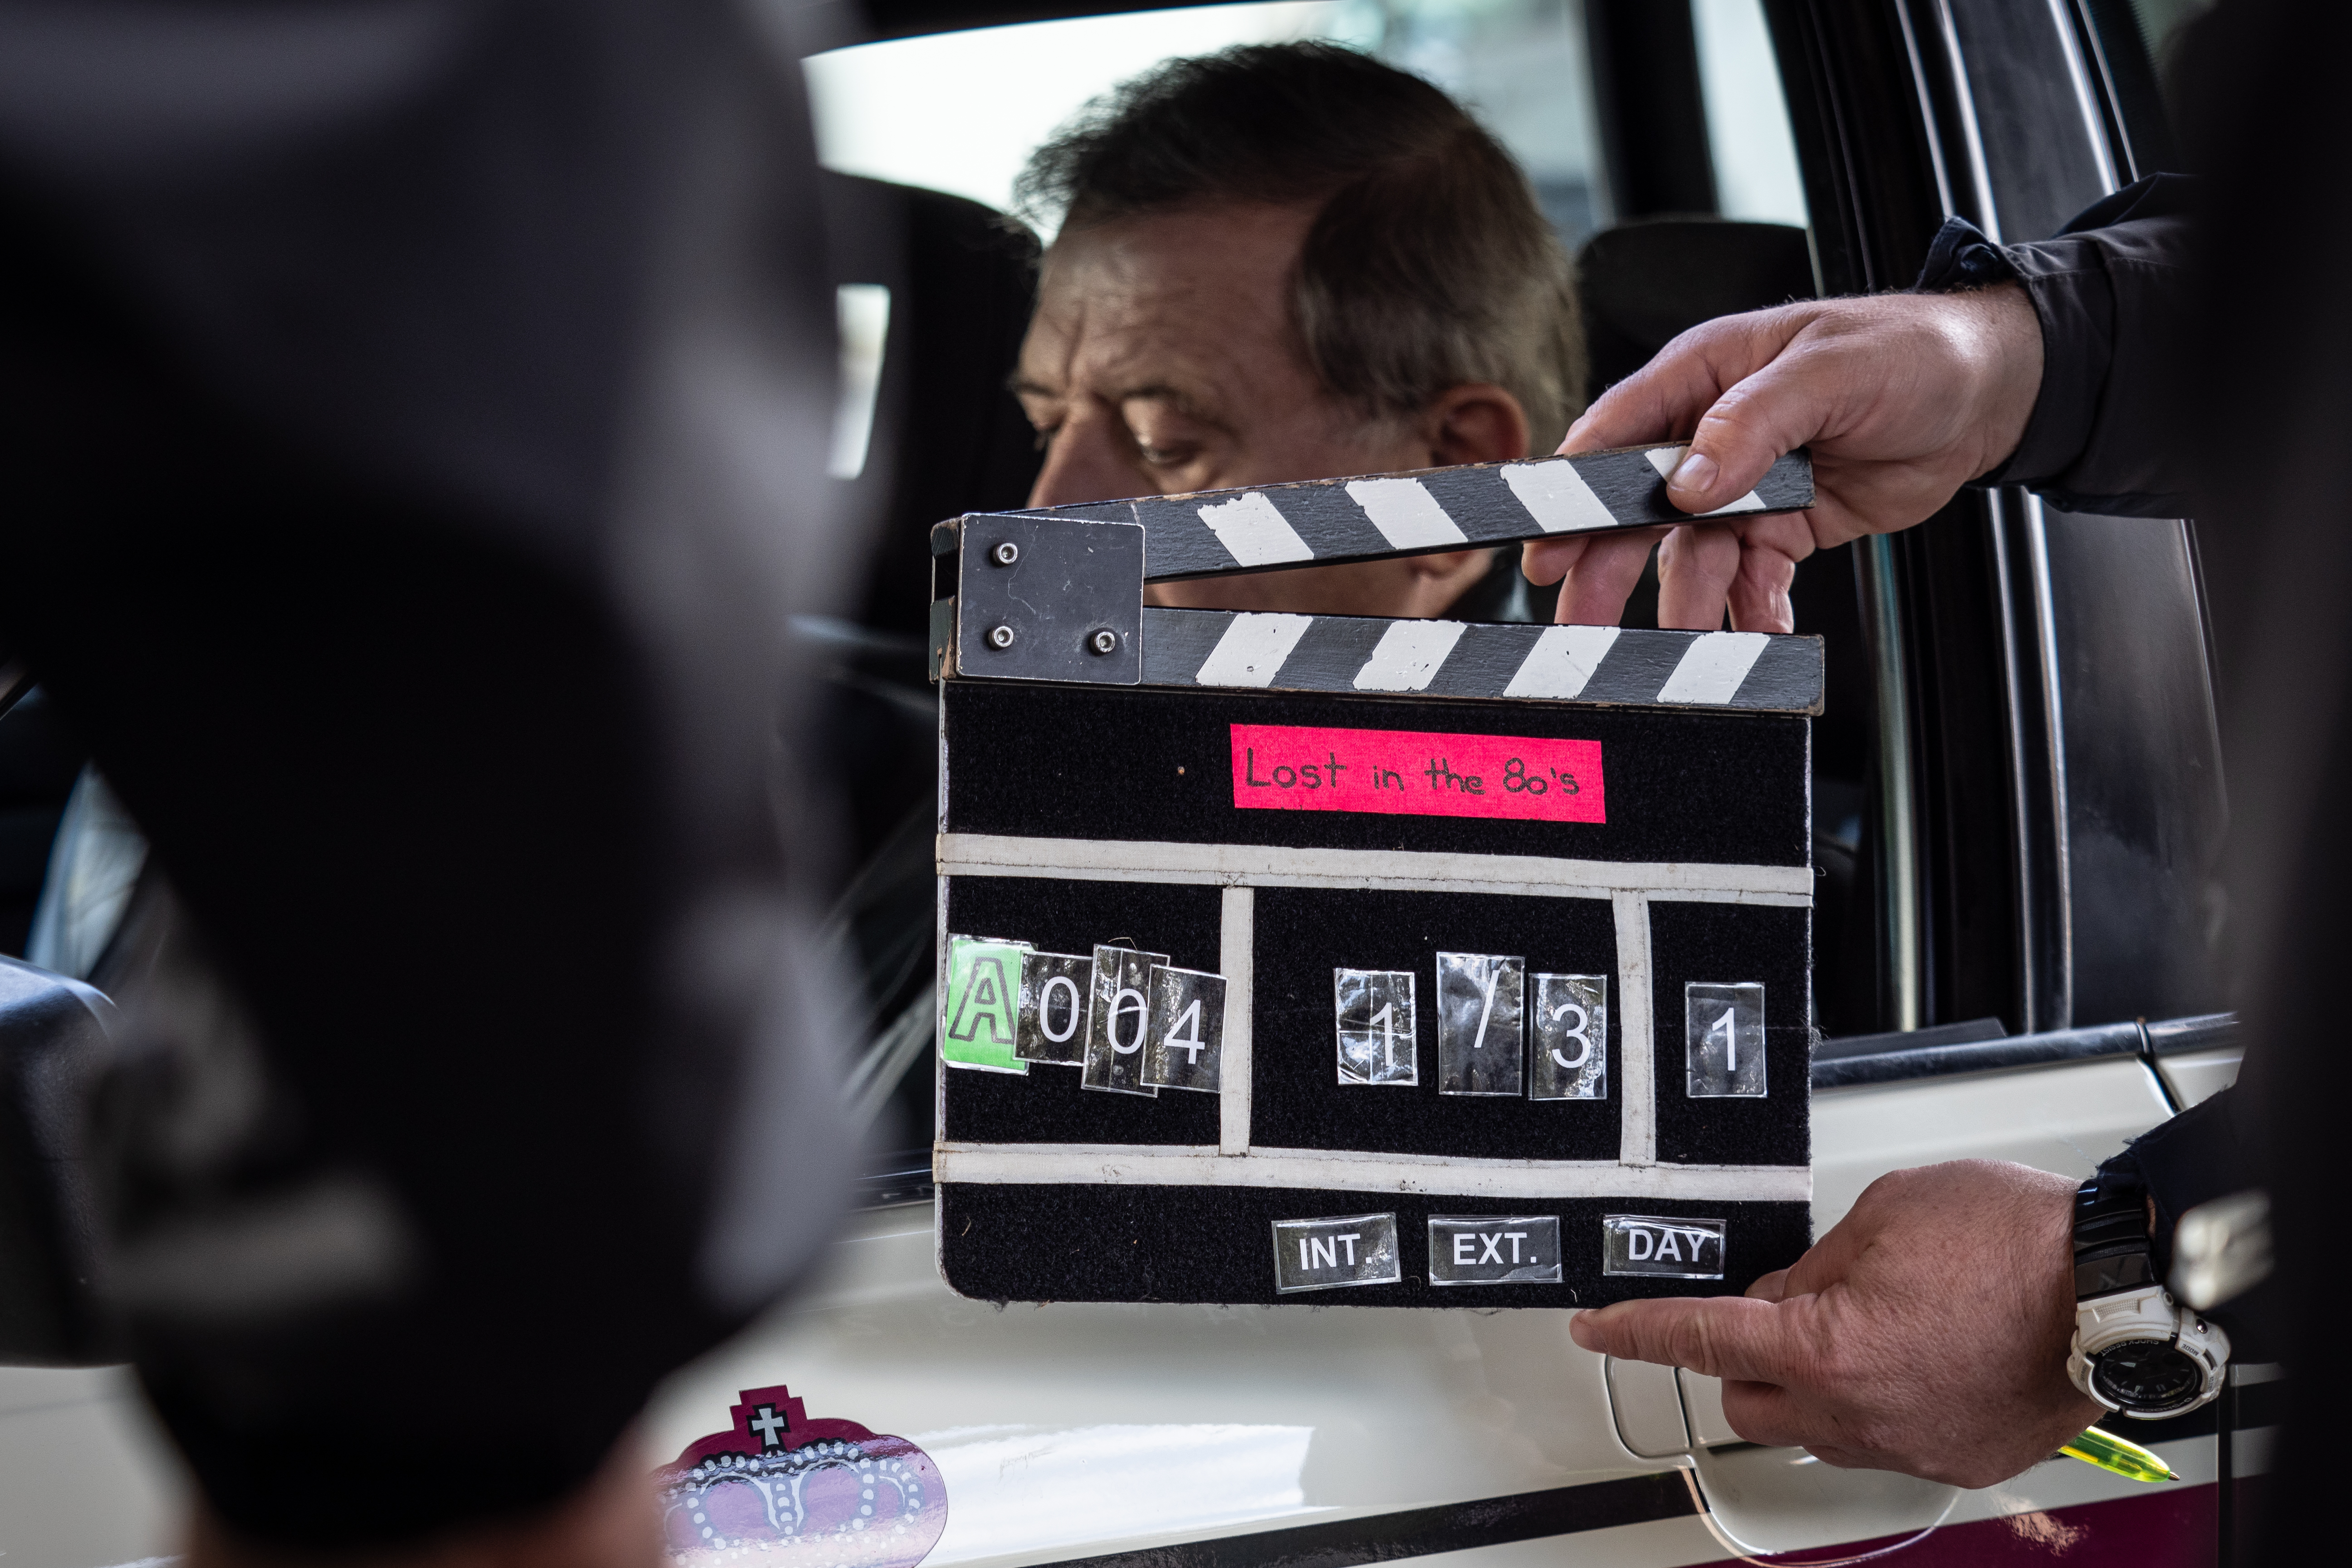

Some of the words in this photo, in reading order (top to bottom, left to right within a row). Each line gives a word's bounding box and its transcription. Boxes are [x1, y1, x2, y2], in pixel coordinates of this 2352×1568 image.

[1246, 748, 1347, 789] Lost
[1373, 765, 1405, 792] in
[1425, 758, 1485, 795] the
[1503, 758, 1580, 796] 80's
[1711, 1007, 1736, 1071] 1
[1299, 1233, 1372, 1270] INT.
[1453, 1231, 1537, 1265] EXT.
[1628, 1229, 1705, 1263] DAY
[2100, 1340, 2127, 1357] RESIST
[2181, 1343, 2199, 1357] MODE
